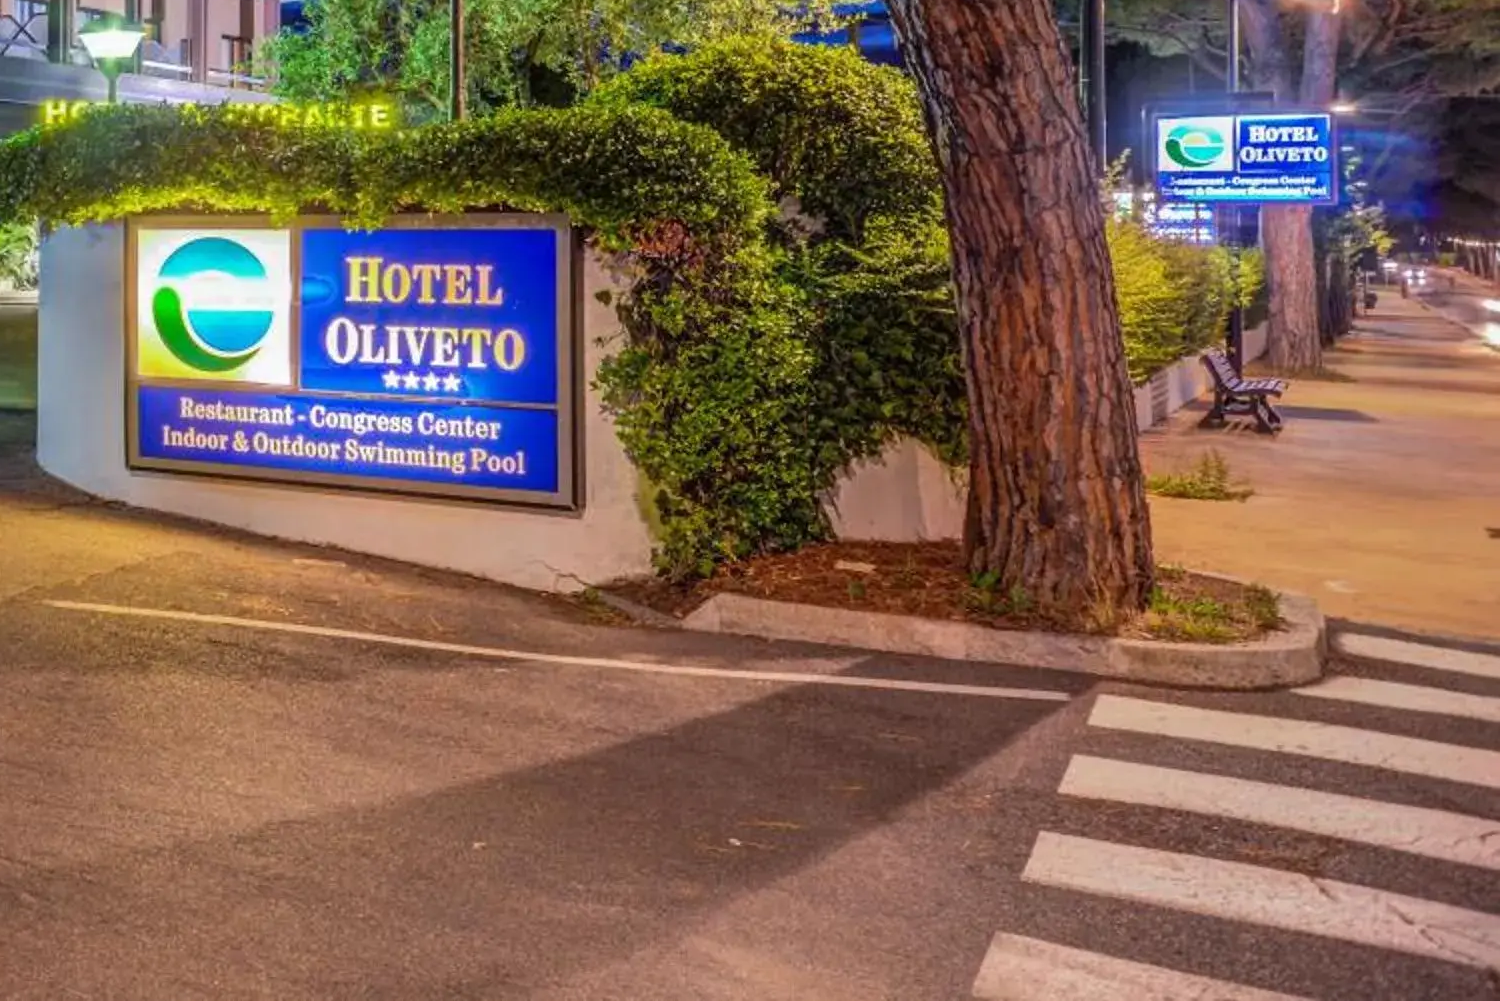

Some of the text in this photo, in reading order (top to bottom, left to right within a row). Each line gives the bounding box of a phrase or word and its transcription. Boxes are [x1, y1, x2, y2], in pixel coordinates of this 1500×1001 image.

[1240, 146, 1328, 163] OLIVETO
[1248, 125, 1319, 143] HOTEL
[345, 256, 504, 306] HOTEL
[325, 317, 525, 370] OLIVETO
[179, 396, 295, 427] Restaurant
[309, 404, 413, 435] Congress
[417, 411, 501, 440] Center
[163, 425, 526, 476] Indoor & Outdoor Swimming Pool
